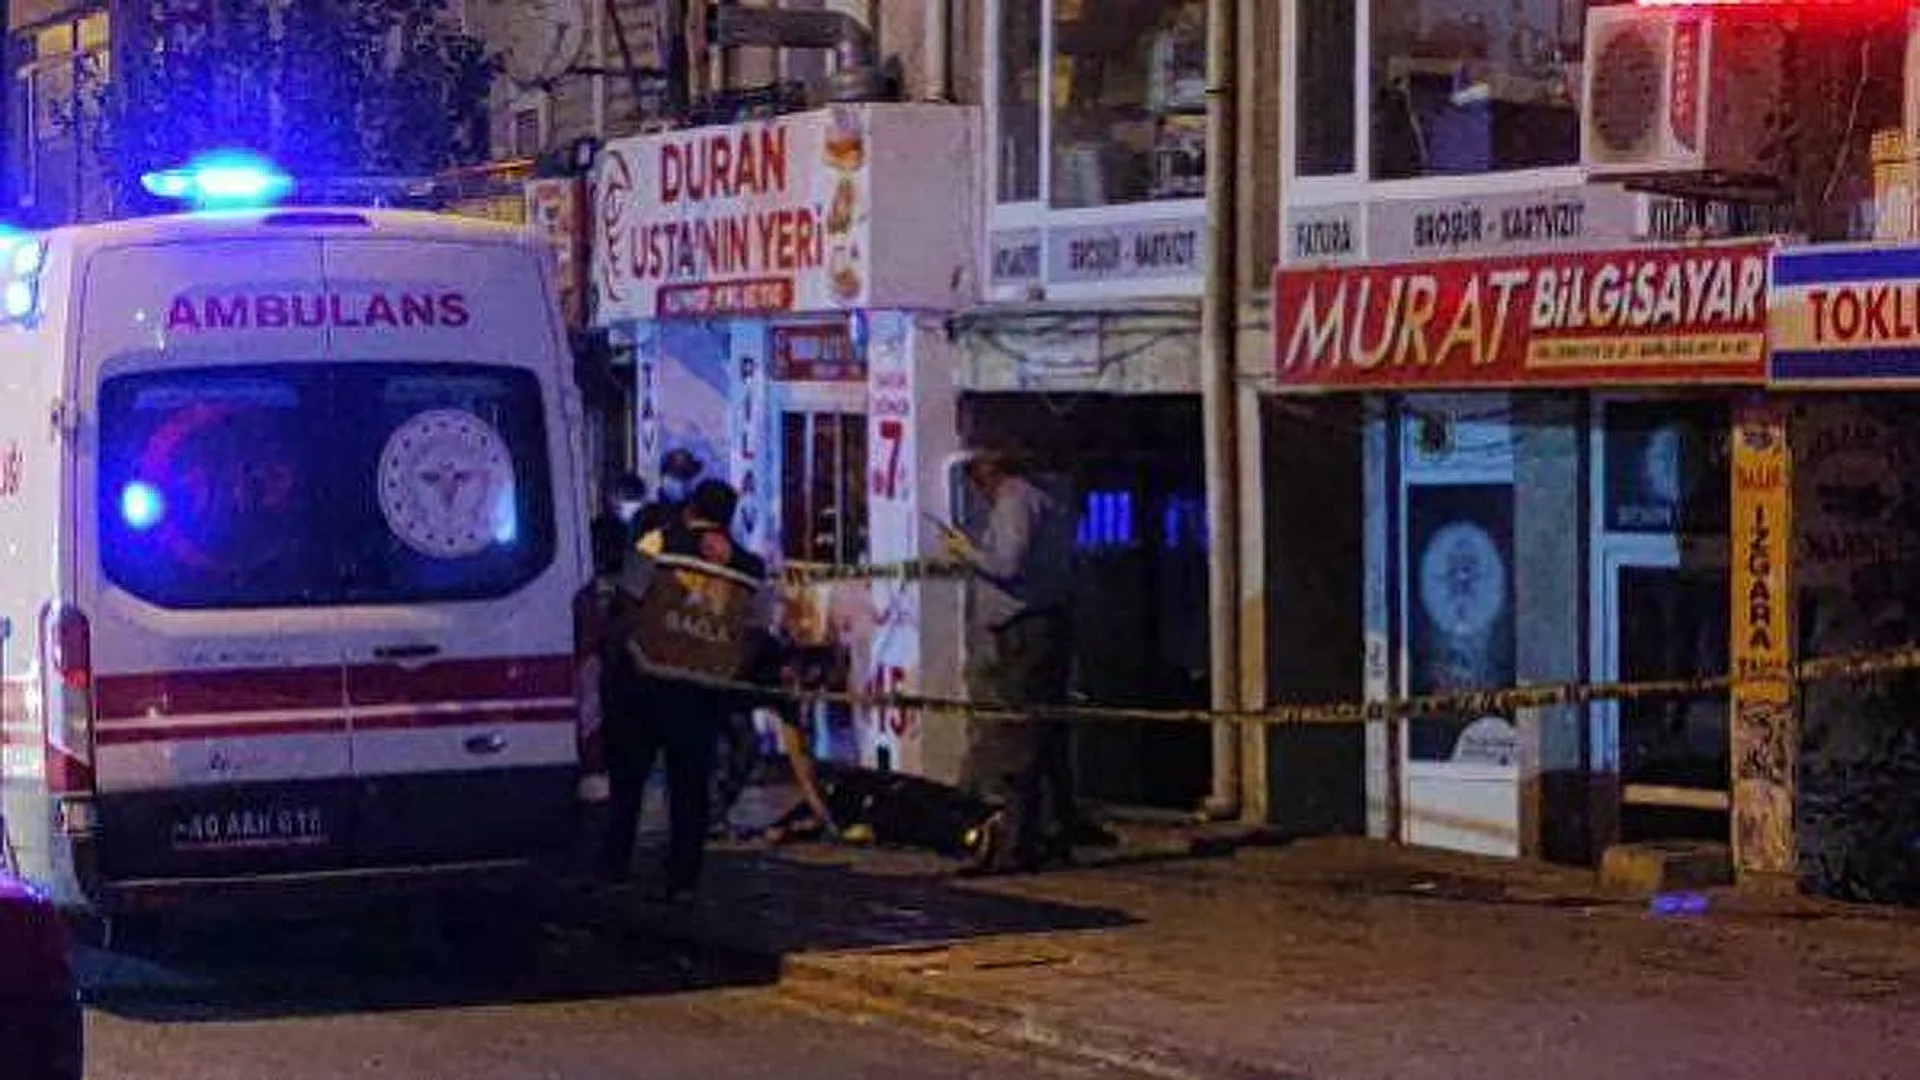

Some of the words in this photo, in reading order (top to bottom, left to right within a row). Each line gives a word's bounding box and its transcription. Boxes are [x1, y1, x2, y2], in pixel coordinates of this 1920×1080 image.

[660, 126, 788, 203] DURAN
[167, 292, 470, 330] AMBULANS
[1285, 270, 1531, 370] MURAT
